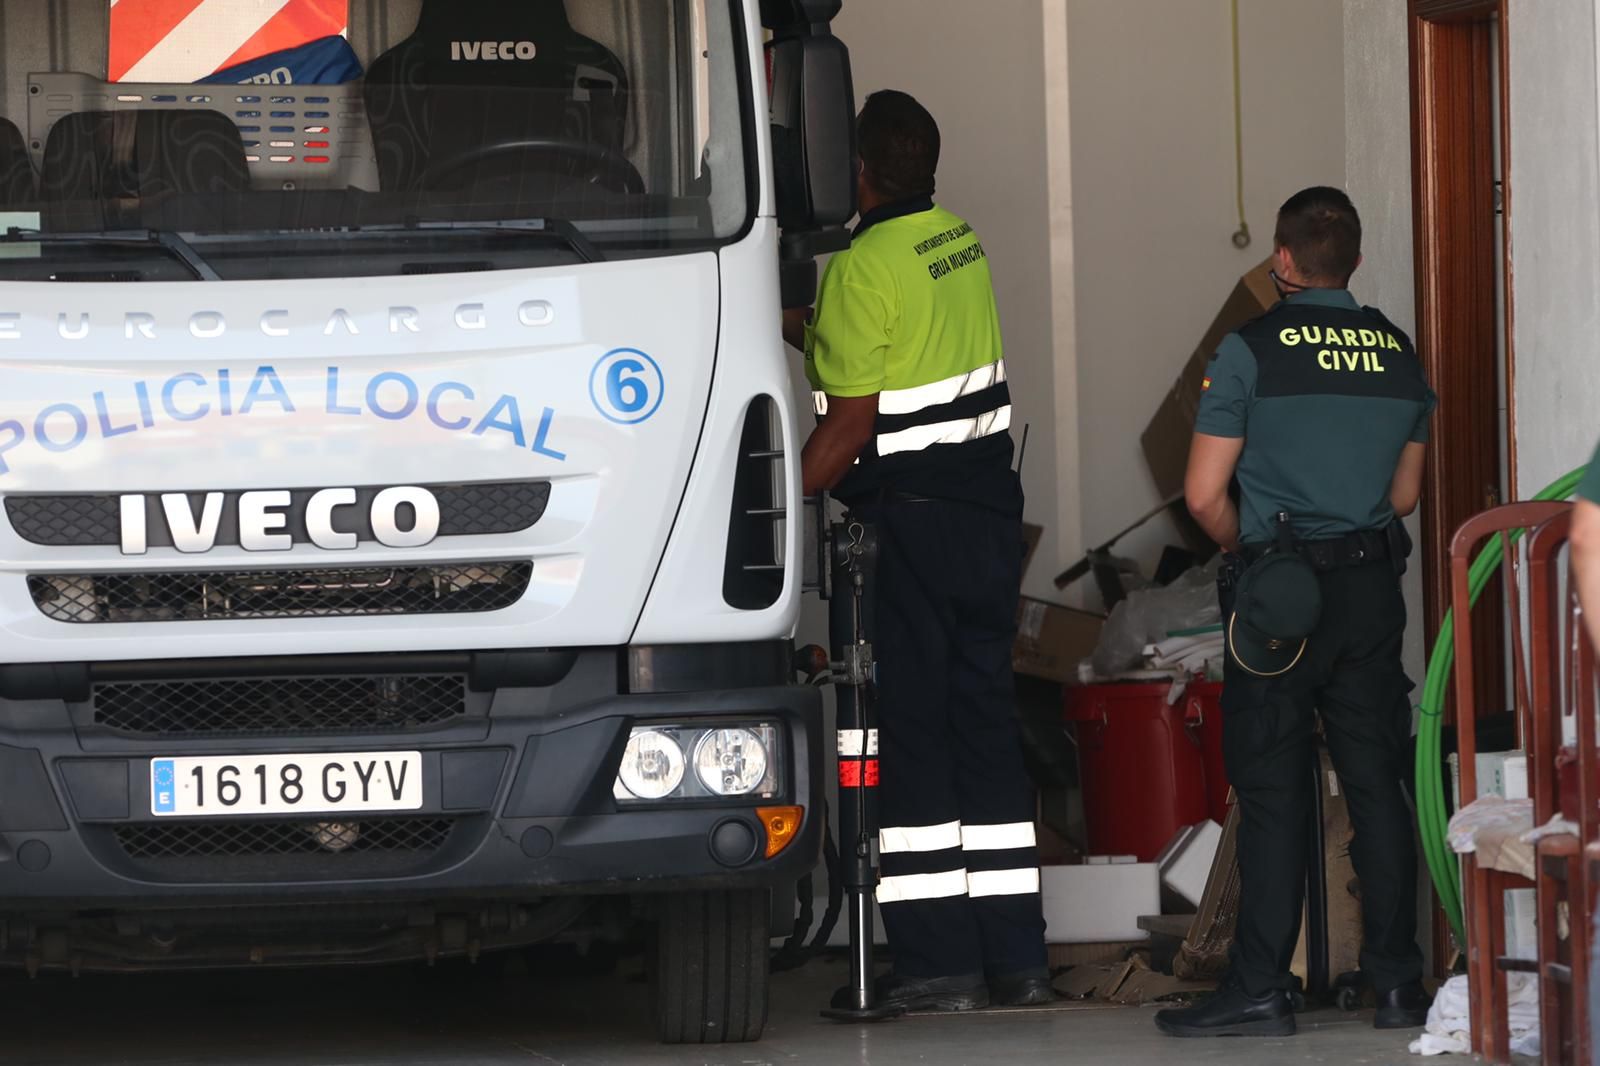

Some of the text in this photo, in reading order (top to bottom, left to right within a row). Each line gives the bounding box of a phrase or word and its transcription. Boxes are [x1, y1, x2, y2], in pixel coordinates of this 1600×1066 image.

[451, 41, 536, 60] IVECO
[946, 229, 956, 241] DE
[928, 241, 986, 280] GRÚA MUNICIPA
[0, 299, 554, 340] EUROCARGO
[1279, 326, 1402, 352] GUARDIA
[1317, 350, 1385, 372] CIVIL
[605, 358, 649, 414] 6
[0, 365, 567, 476] POLICIA LOCAL
[119, 485, 441, 556] IVECO
[159, 792, 170, 804] E
[191, 760, 408, 807] 1618 GYV
